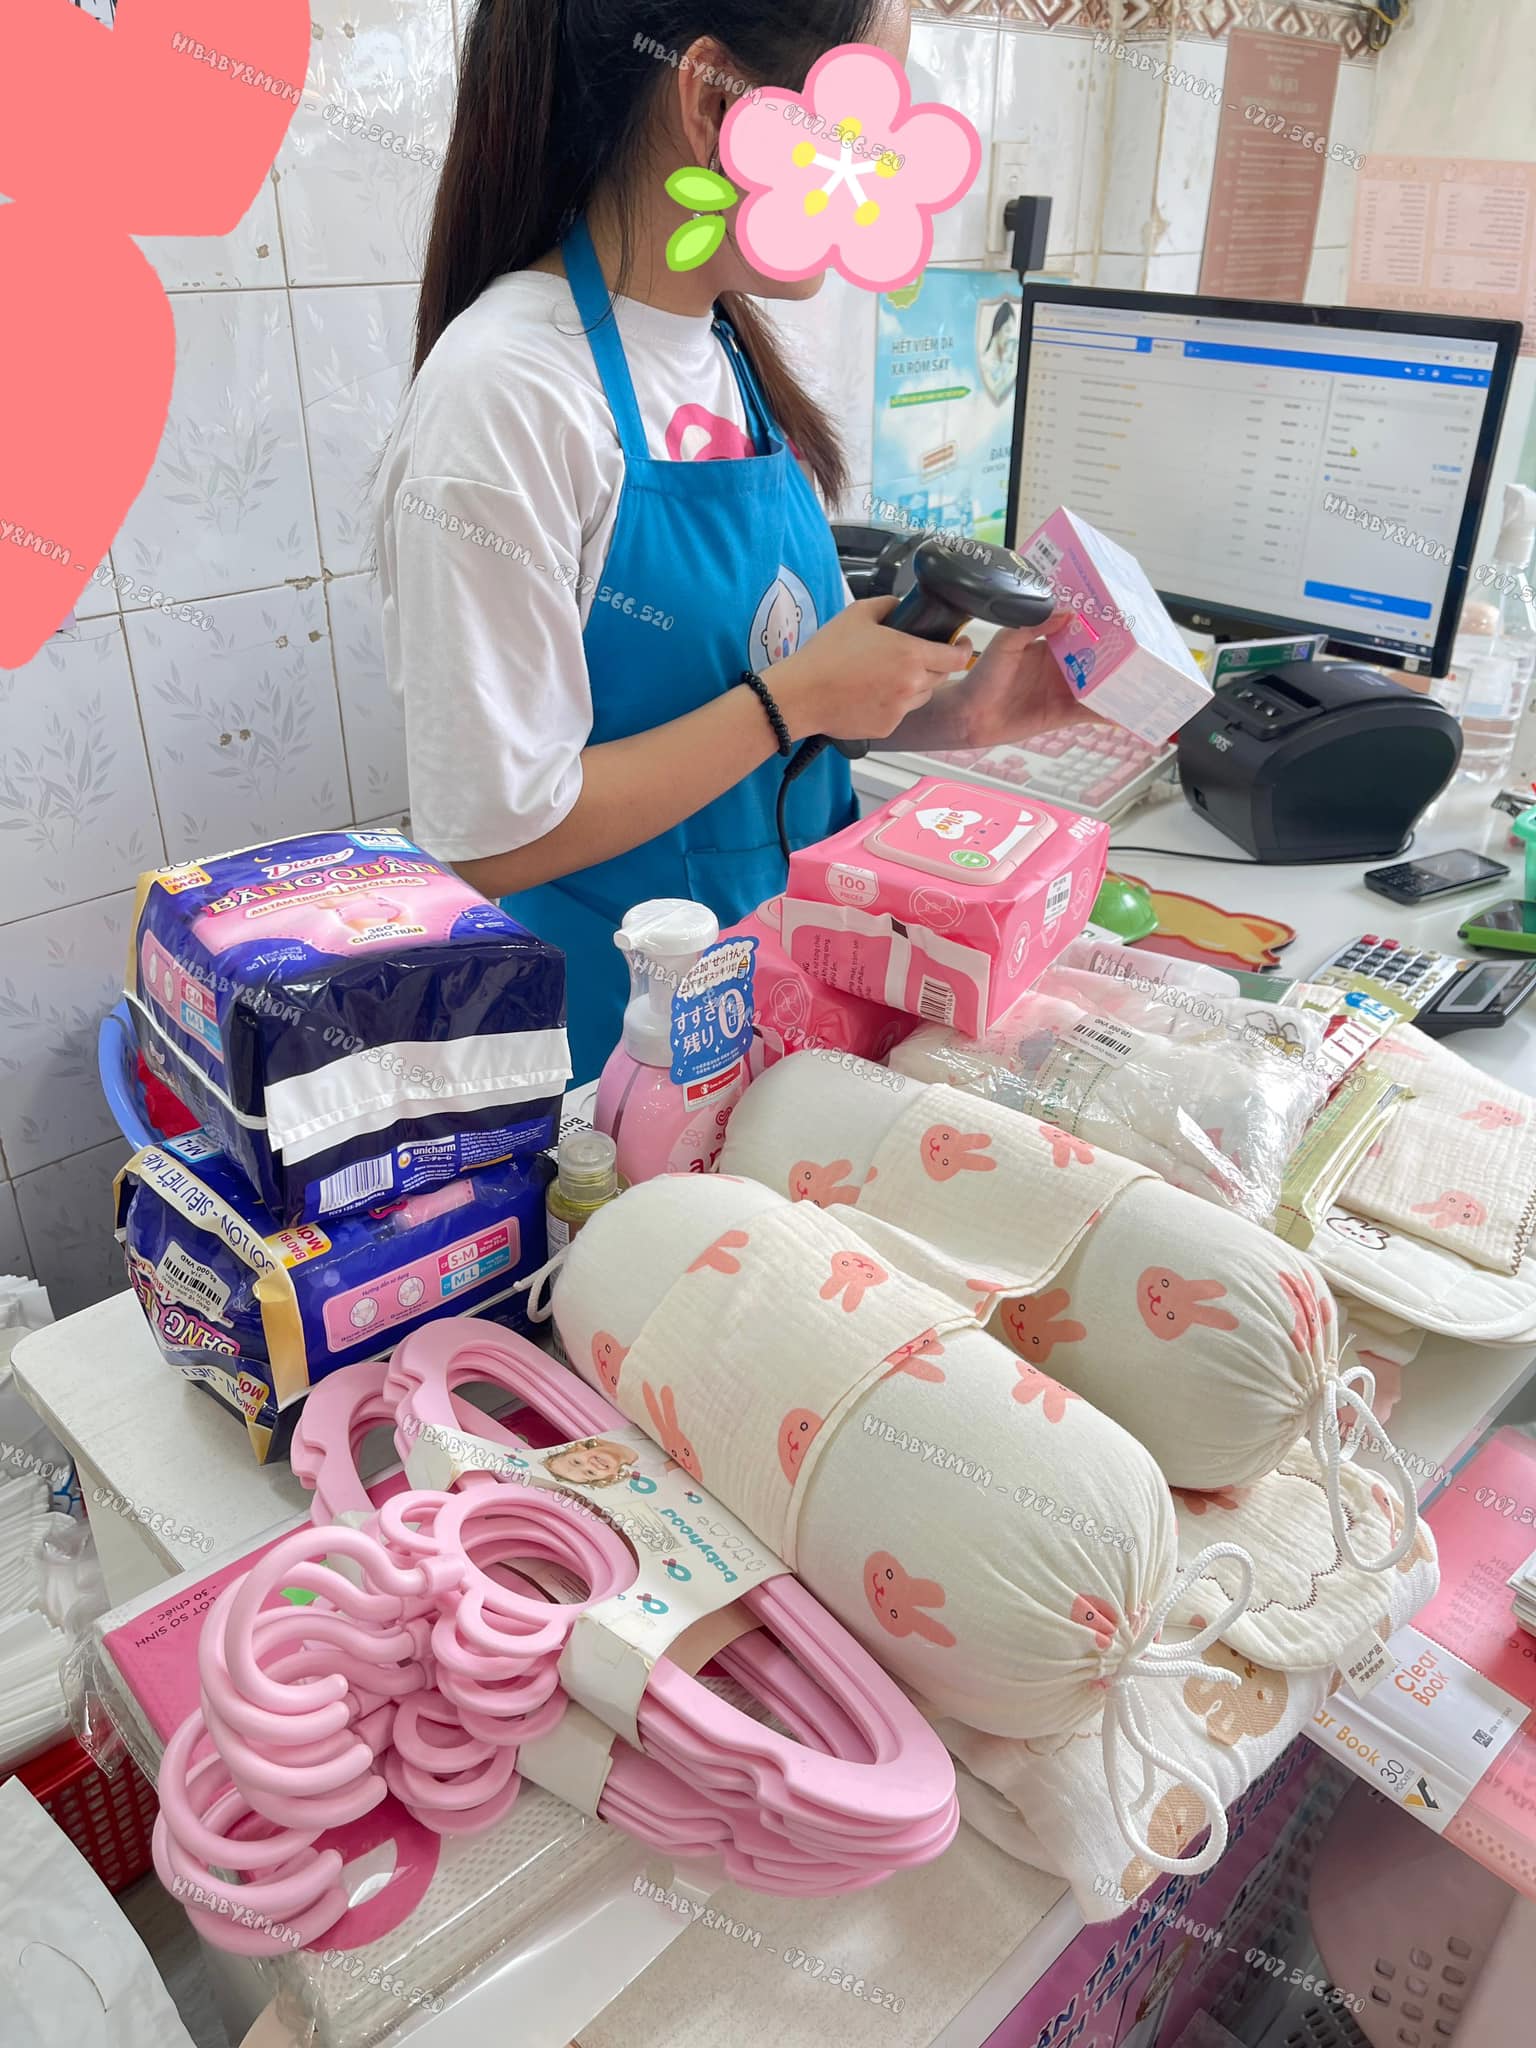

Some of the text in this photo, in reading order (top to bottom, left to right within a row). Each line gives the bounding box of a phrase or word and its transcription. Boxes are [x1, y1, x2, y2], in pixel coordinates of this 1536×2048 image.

[272, 852, 338, 878] Diana
[837, 874, 866, 892] 100
[683, 1025, 714, 1058] 残り
[177, 1138, 206, 1157] M-L
[412, 1143, 456, 1155] unicharm
[155, 1168, 188, 1195] TIẾT
[181, 1191, 214, 1217] SIÊU
[450, 1247, 478, 1267] S-M
[453, 1267, 479, 1286] M-L
[660, 1507, 738, 1584] babyhood
[193, 1588, 209, 1601] 30
[157, 1599, 191, 1621] chiếc
[135, 1625, 168, 1648] SINH
[1394, 1649, 1440, 1694] Clear
[1411, 1670, 1451, 1707] Book
[1335, 1724, 1381, 1768] Book
[1379, 1759, 1405, 1784] 30
